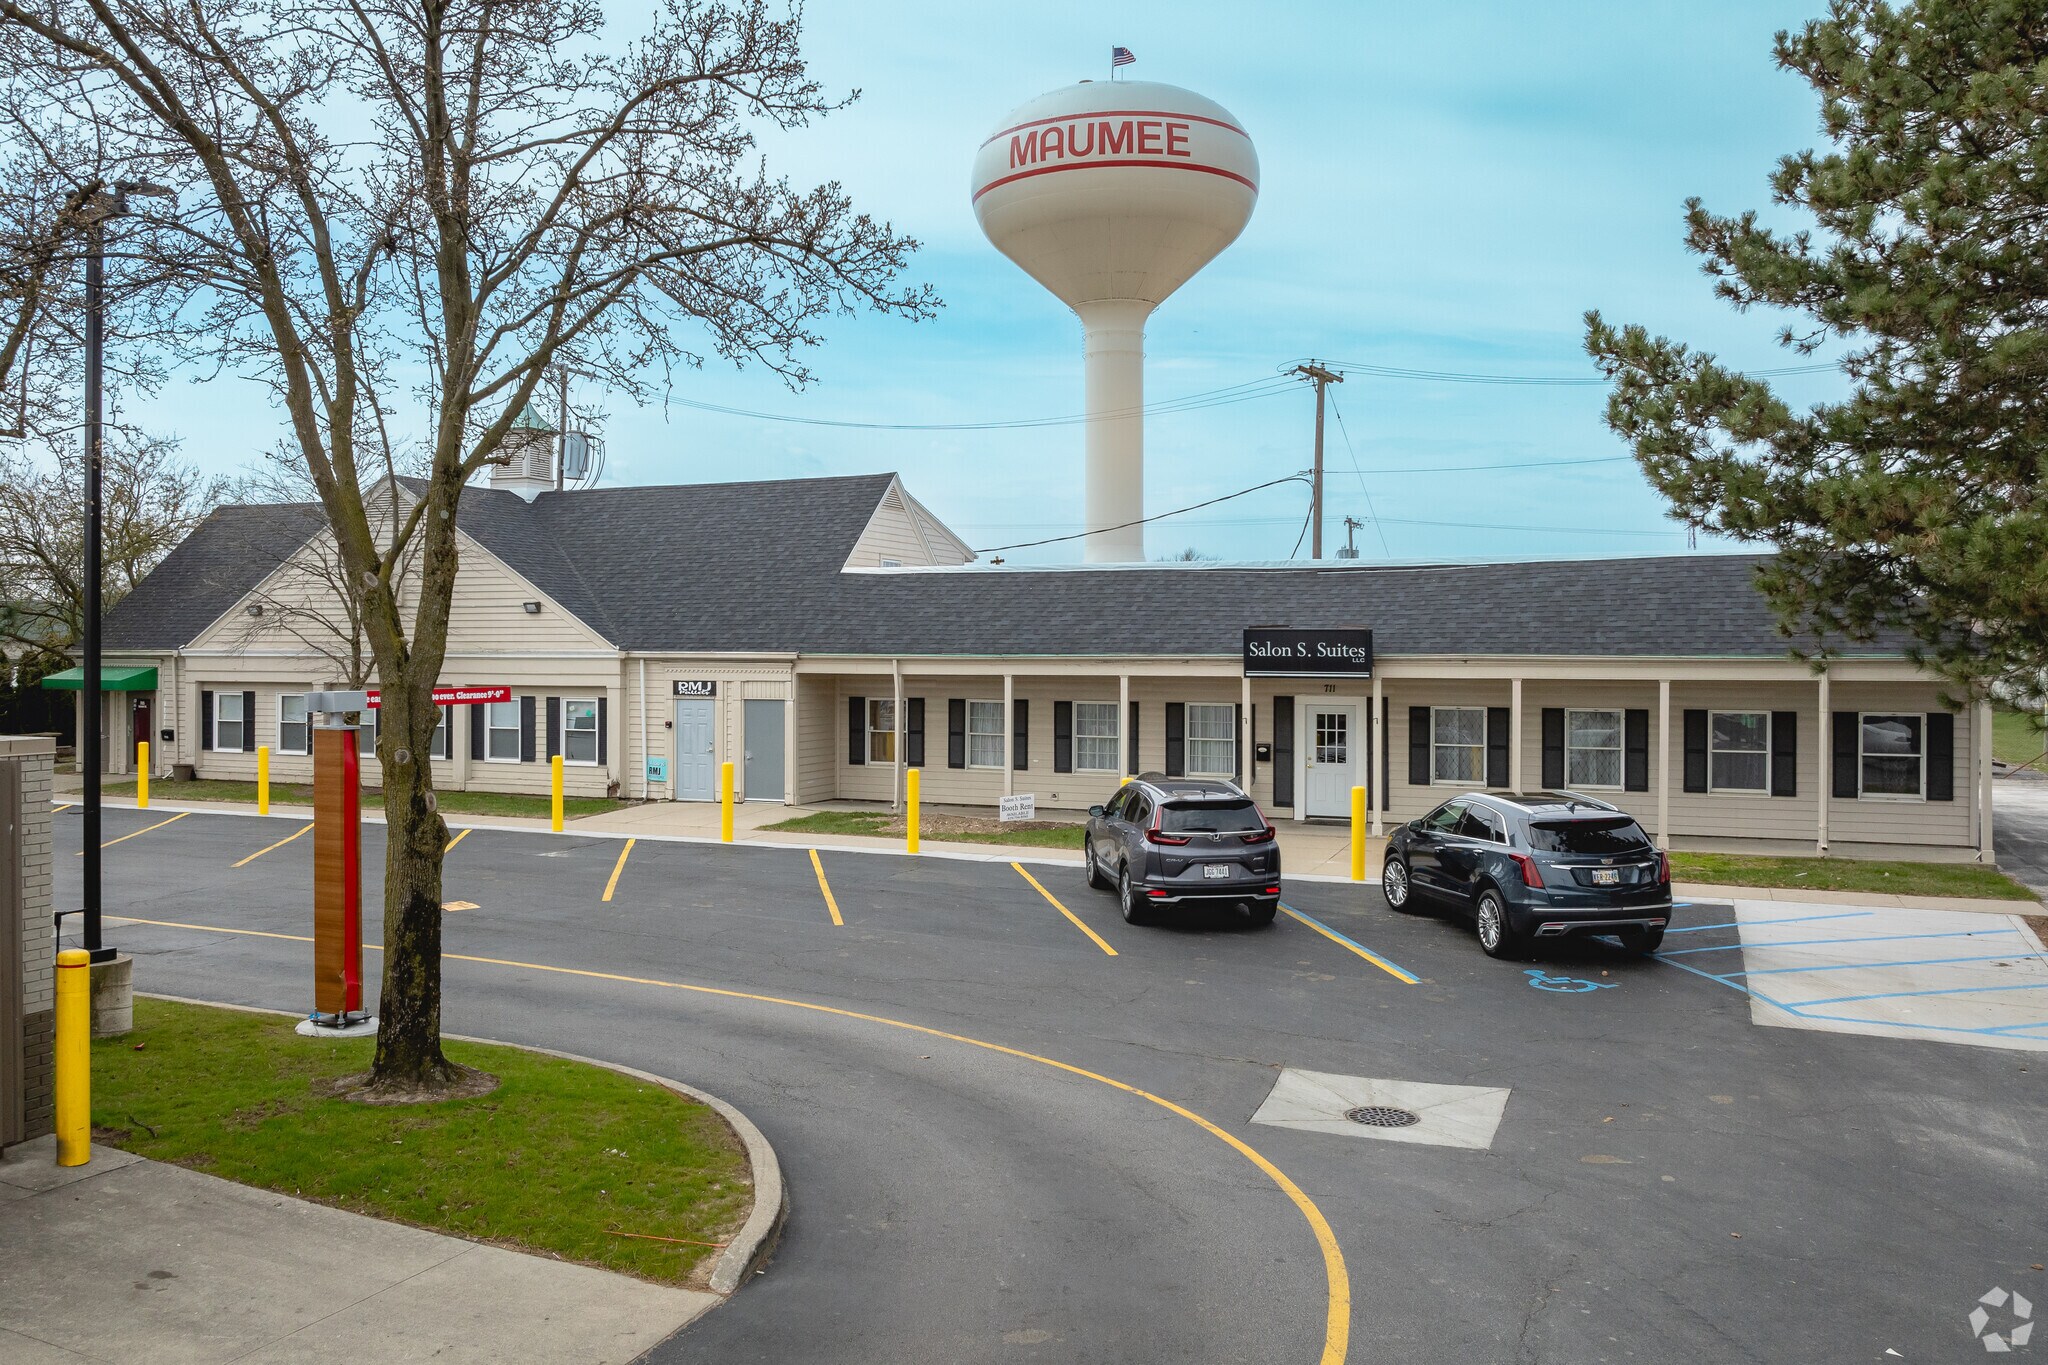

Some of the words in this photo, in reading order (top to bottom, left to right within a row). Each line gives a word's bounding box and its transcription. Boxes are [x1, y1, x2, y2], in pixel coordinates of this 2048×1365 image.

[1009, 120, 1191, 169] MAUMEE
[1249, 641, 1292, 657] Salon
[1297, 641, 1311, 658] S.
[1317, 641, 1366, 658] Suites
[678, 681, 712, 692] RMJ
[1323, 684, 1336, 693] 711
[440, 693, 455, 701] ever.
[456, 691, 487, 700] Clearance
[648, 766, 661, 776] RMJ
[1001, 804, 1019, 812] Booth
[1020, 802, 1033, 811] Rent
